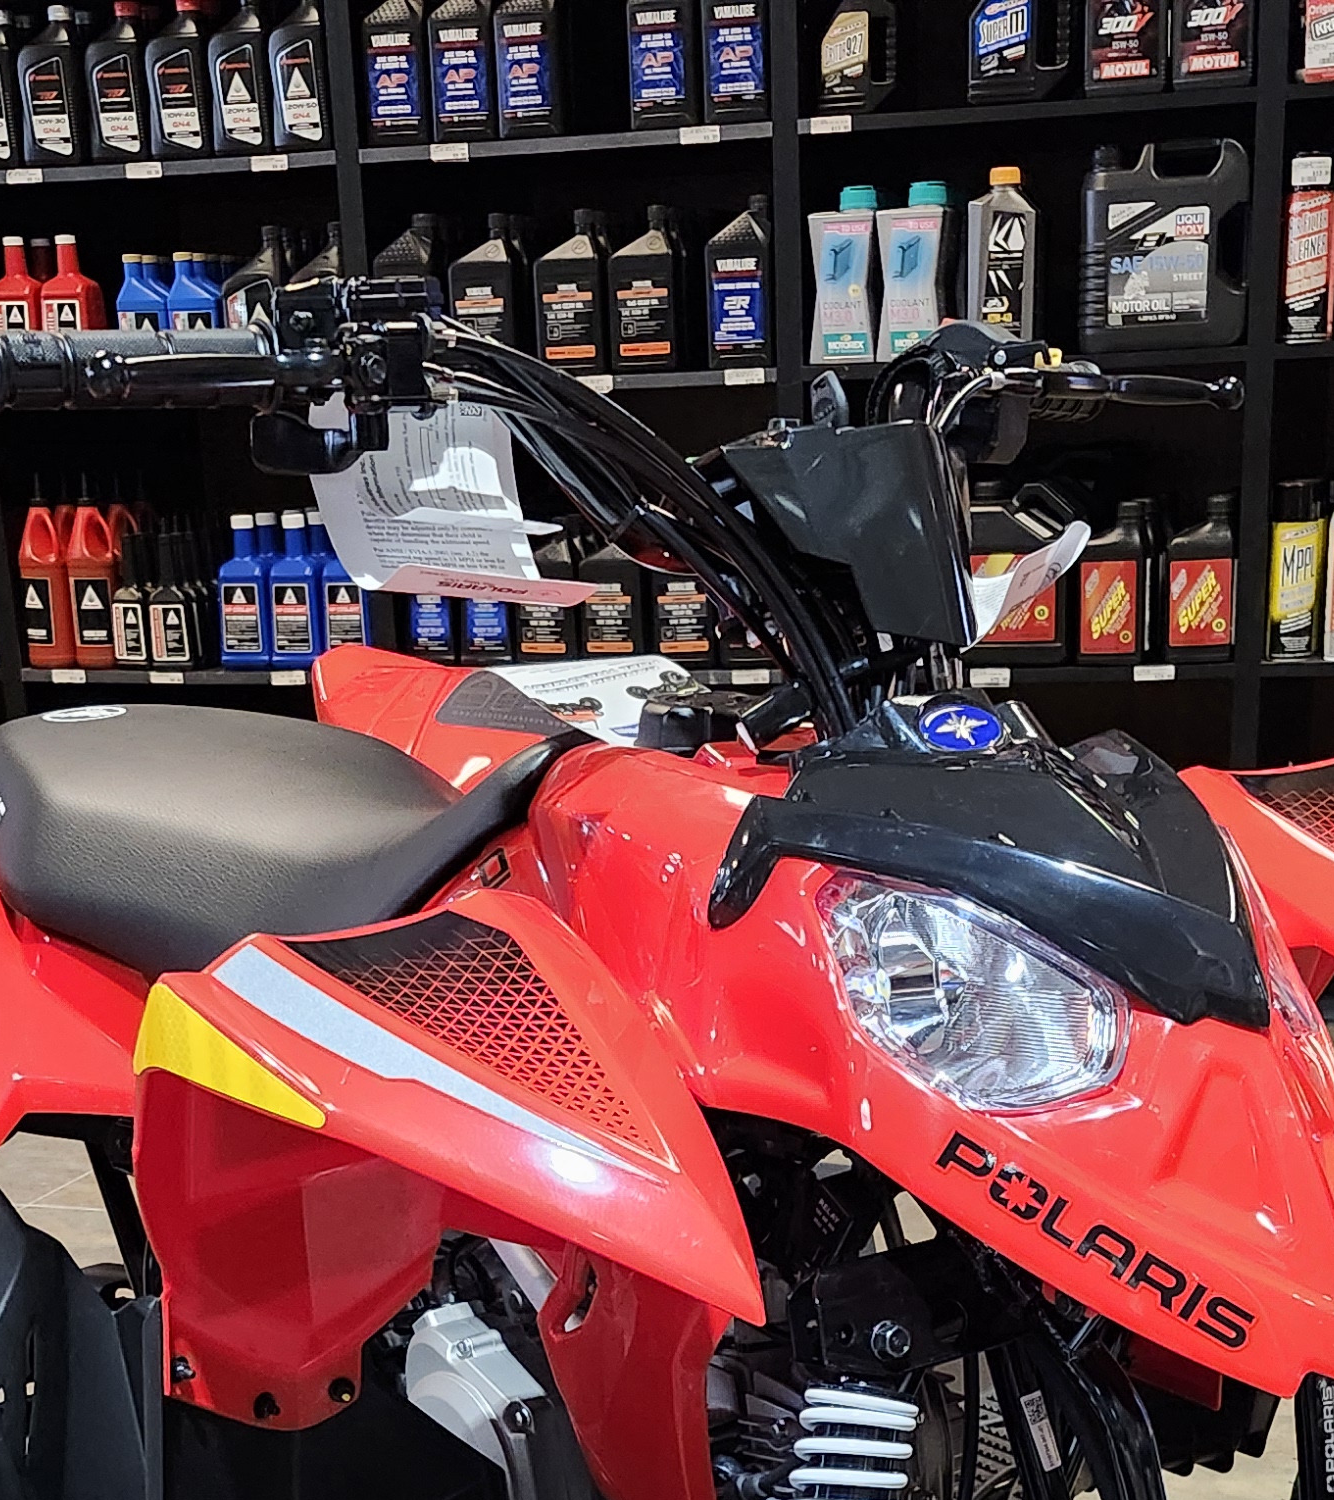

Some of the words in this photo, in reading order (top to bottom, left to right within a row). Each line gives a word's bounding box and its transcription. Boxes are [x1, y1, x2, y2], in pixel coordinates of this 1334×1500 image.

[1098, 12, 1154, 35] 300V
[1186, 3, 1245, 28] 300V
[1102, 60, 1149, 79] MOTUL
[1190, 53, 1238, 72] MOTUL
[851, 223, 867, 231] USE
[919, 220, 935, 229] USE
[1176, 213, 1205, 225] LIQUI
[1175, 224, 1204, 236] MOLY
[1110, 255, 1145, 274] SAE
[1173, 272, 1204, 282] STREET
[823, 301, 862, 311] COOLANT
[890, 298, 930, 308] COOLANT
[1111, 300, 1151, 313] MOTOR
[1151, 299, 1171, 311] OIL
[437, 581, 528, 596] POLARIS
[1090, 579, 1126, 641] SUPER
[1178, 570, 1218, 635] SUPER
[818, 1198, 840, 1223] RELAY
[936, 1133, 1256, 1349] POLARIS
